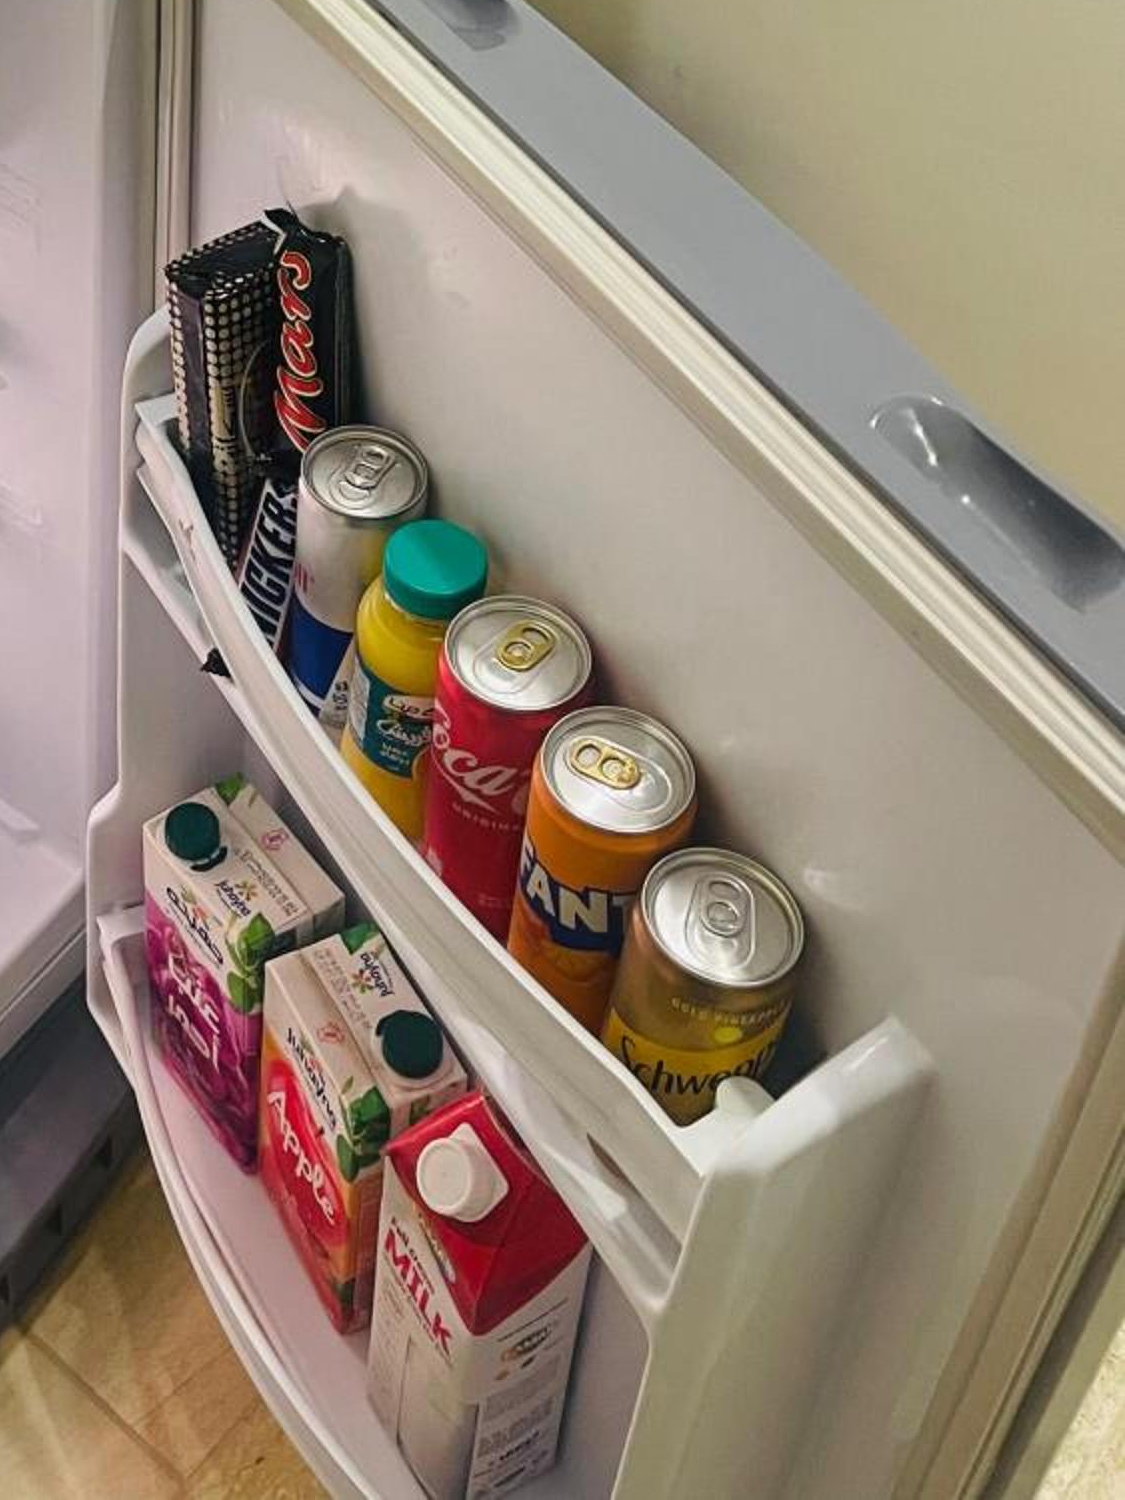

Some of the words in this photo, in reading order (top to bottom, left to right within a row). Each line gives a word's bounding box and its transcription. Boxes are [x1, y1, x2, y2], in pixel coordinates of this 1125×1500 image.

[273, 250, 328, 454] Mars
[520, 830, 635, 933] FANT
[268, 1092, 335, 1226] Apple
[385, 1228, 452, 1357] MILK
